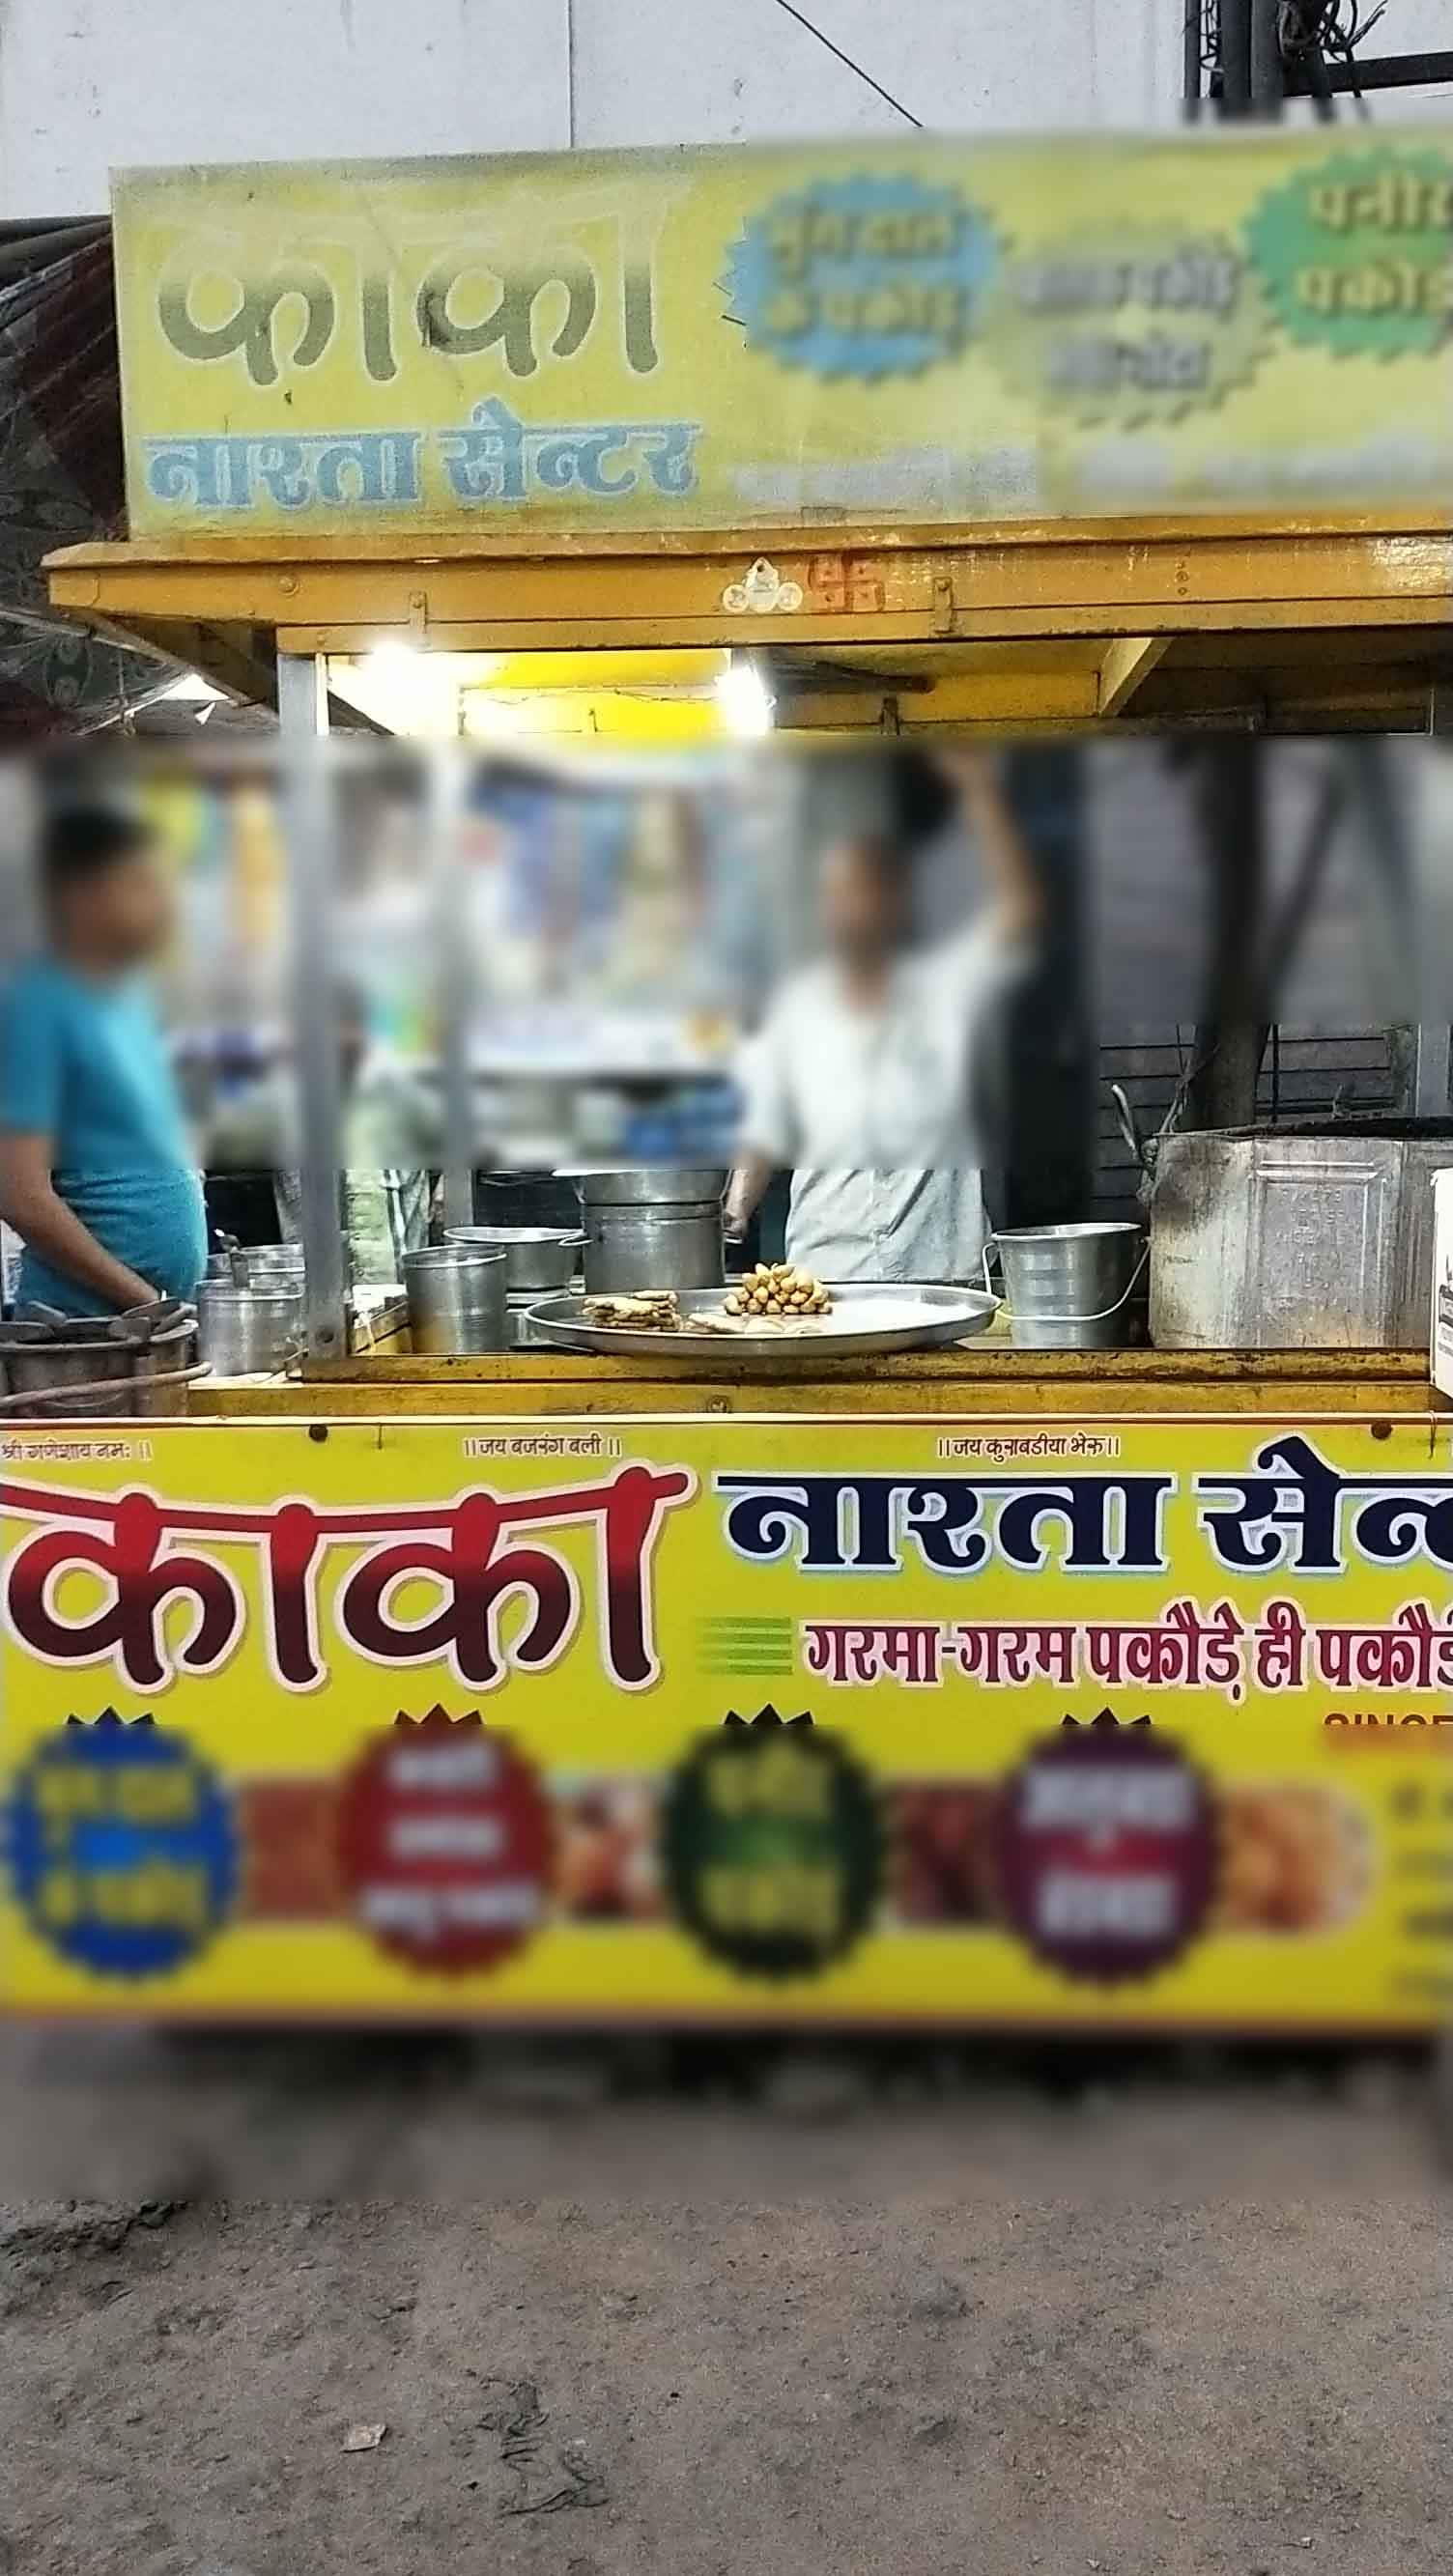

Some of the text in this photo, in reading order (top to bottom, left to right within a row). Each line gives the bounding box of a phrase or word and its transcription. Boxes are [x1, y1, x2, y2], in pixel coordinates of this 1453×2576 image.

[135, 180, 692, 385] काका
[0, 1464, 689, 1685] काका
[1255, 1601, 1302, 1685] ही
